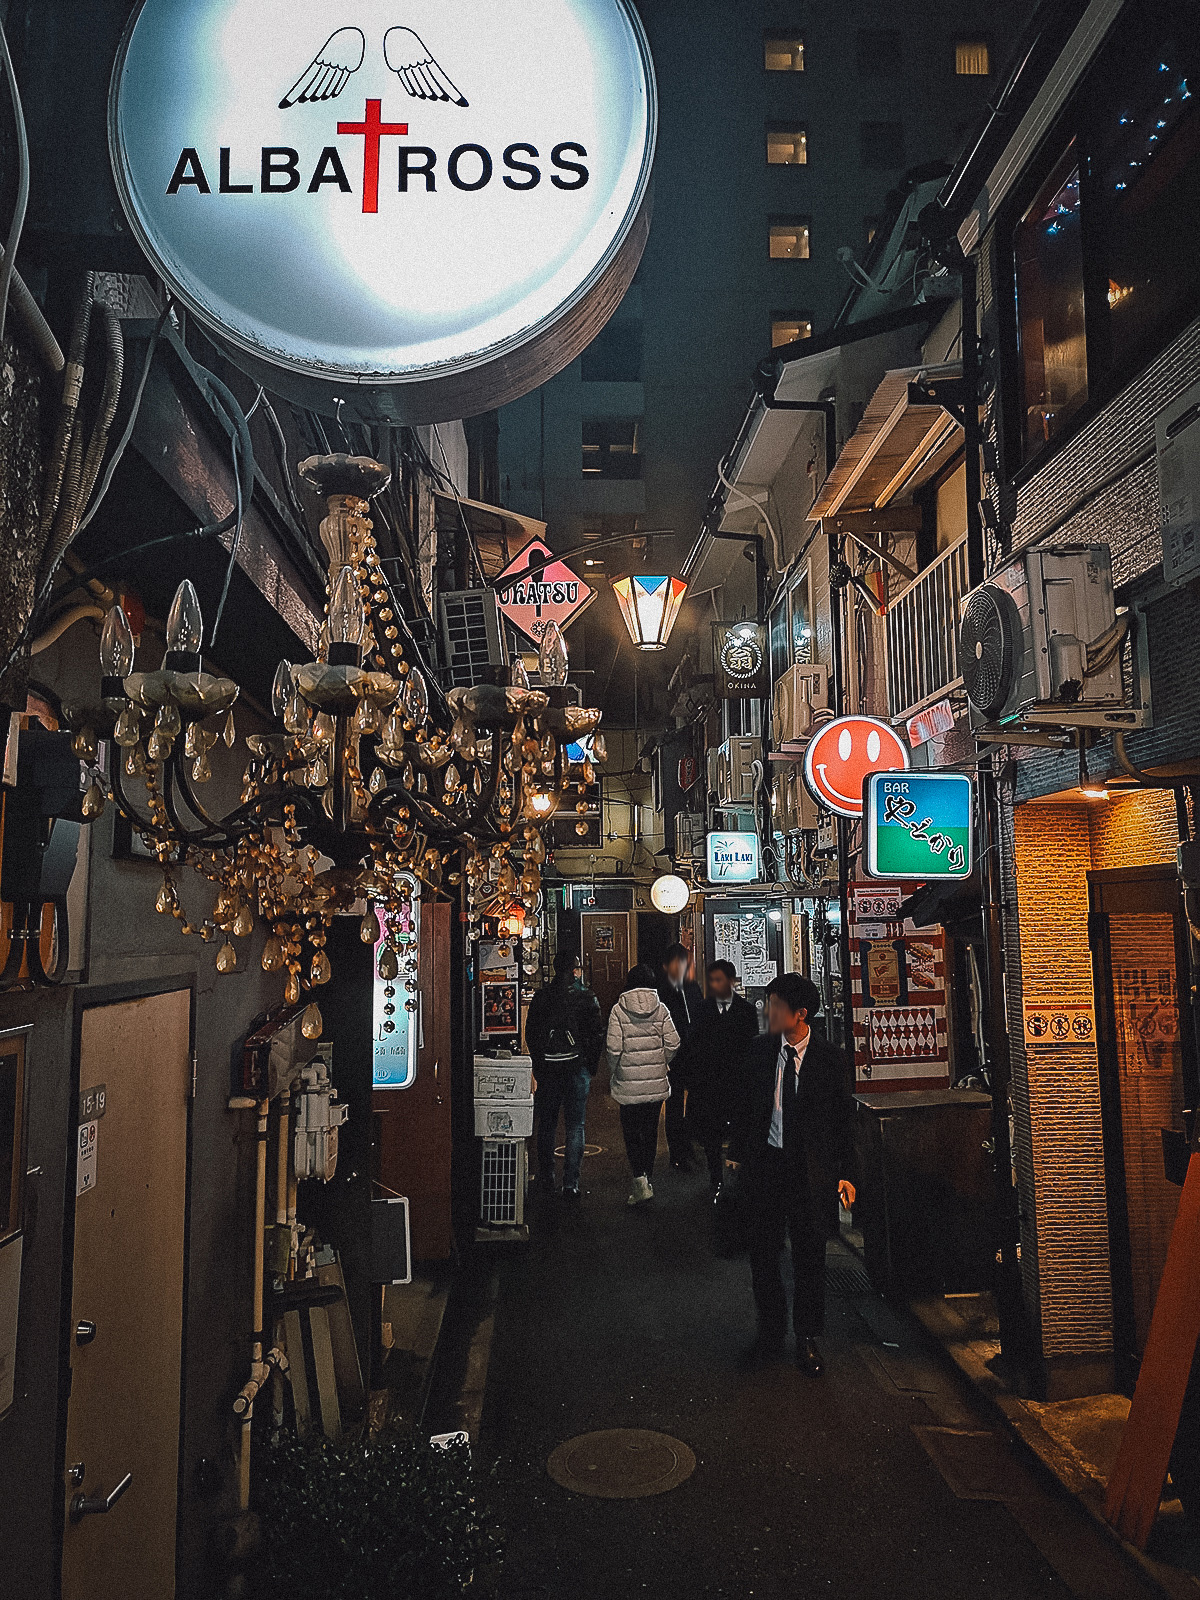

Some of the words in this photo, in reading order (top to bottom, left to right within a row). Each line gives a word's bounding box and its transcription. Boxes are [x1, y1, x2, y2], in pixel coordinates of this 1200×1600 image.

[165, 98, 591, 214] ALBATROSS
[884, 782, 909, 793] BAR
[884, 795, 965, 871] やどかり
[82, 1091, 107, 1116] 15-19
